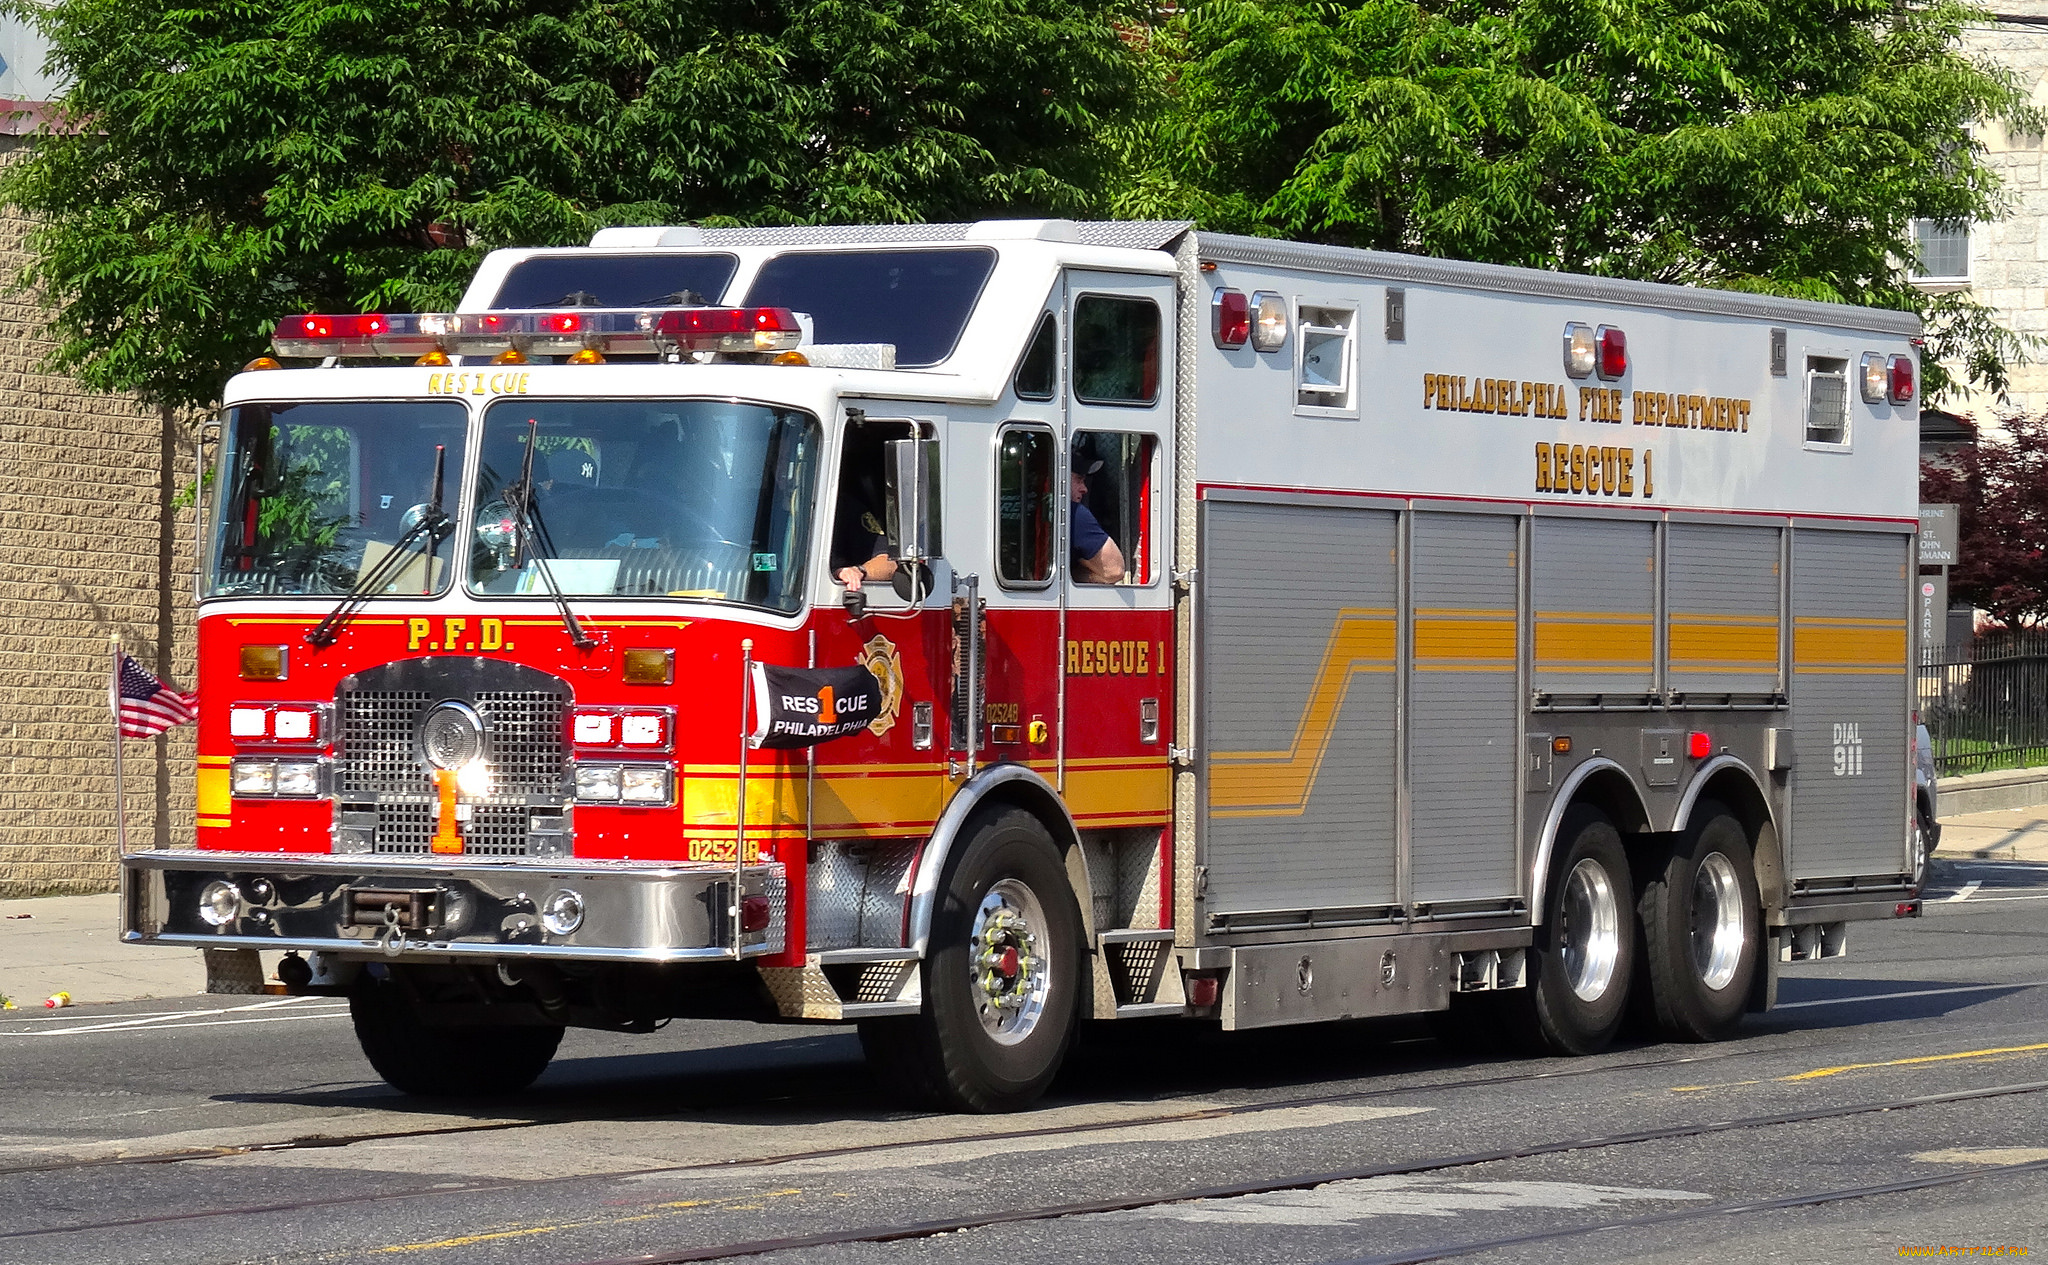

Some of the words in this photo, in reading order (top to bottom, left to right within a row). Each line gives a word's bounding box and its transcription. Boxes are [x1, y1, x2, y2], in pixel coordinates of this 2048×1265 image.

[1423, 373, 1568, 420] PHILADELPHIA
[1579, 386, 1623, 424] FIRE
[1632, 390, 1751, 433] DEPARTMENT
[1535, 441, 1634, 497] RESCUE
[1643, 449, 1654, 498] 1
[1920, 509, 1944, 517] HRINE
[1920, 540, 1940, 549] OHN
[407, 618, 515, 651] P.F.D.
[1066, 640, 1149, 677] RESCUE
[1157, 640, 1166, 677] 1
[986, 703, 1019, 723] 025248
[773, 718, 868, 738] PHILADELPHIA
[1833, 722, 1862, 745] DIAL
[1833, 745, 1862, 776] 911
